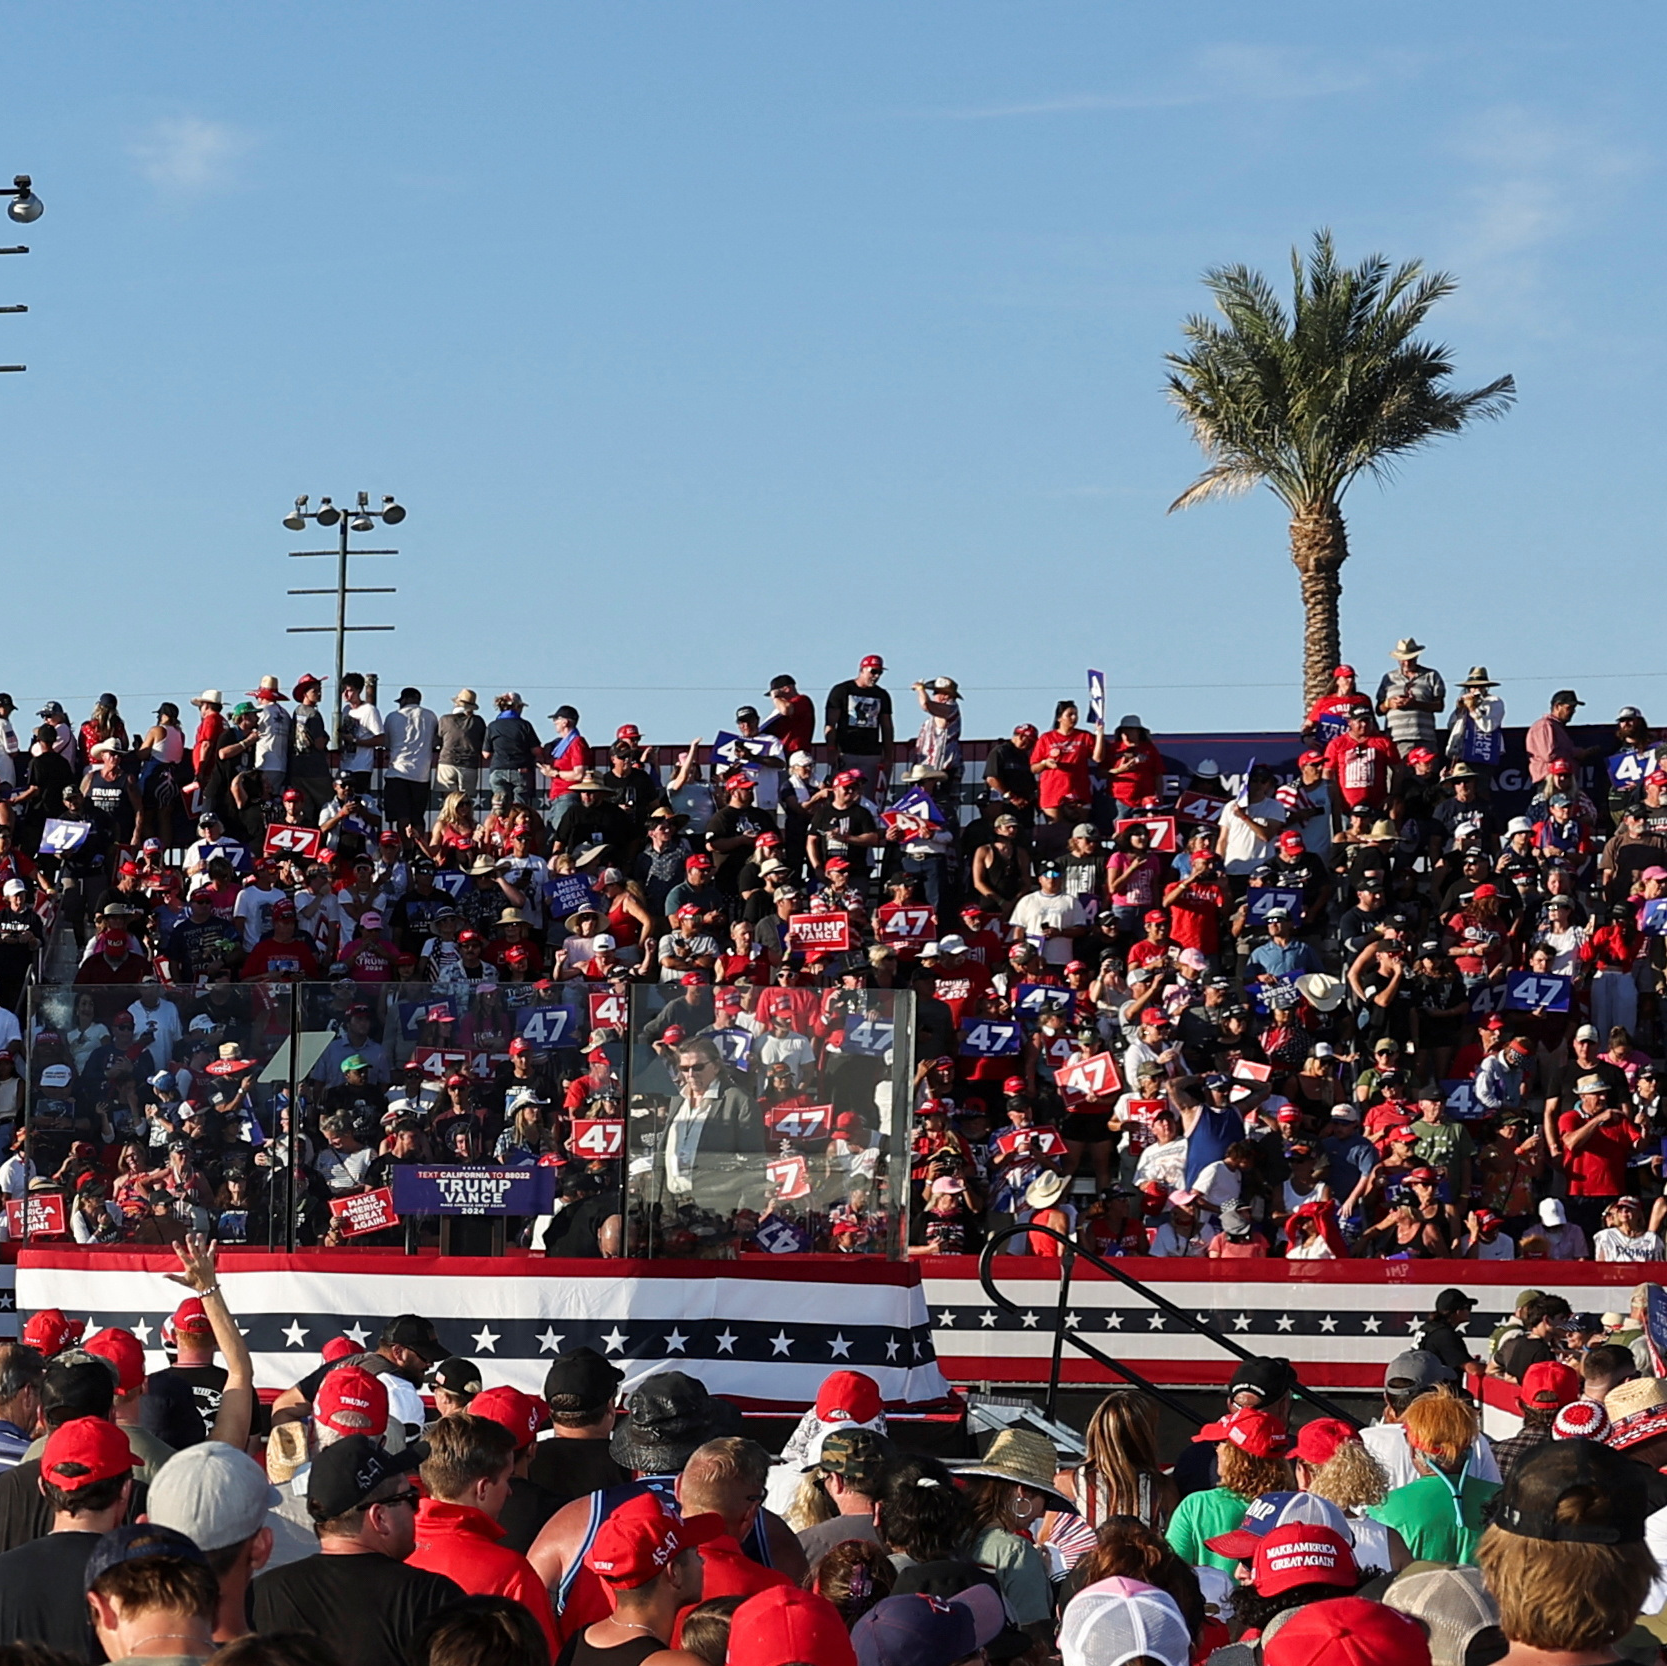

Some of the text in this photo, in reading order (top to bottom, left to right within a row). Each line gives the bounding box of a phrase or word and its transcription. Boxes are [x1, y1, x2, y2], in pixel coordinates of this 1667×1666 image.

[1614, 749, 1657, 781] 47
[92, 788, 122, 797] TRUMP
[46, 824, 86, 850] 47
[269, 829, 315, 852] 47
[1145, 822, 1168, 848] 7
[552, 883, 586, 899] AMERICA
[556, 877, 579, 889] MAKE
[559, 890, 586, 903] GREAT
[1251, 892, 1297, 914] 47
[0, 922, 30, 931] TRUMP
[792, 921, 845, 933] TRUMP
[886, 910, 930, 936] 47
[798, 931, 840, 942] VANCE
[1512, 977, 1563, 1006] 47
[523, 1011, 567, 1042] 47
[966, 1024, 1014, 1051] 47
[1068, 1059, 1108, 1092] 47
[775, 1111, 825, 1137] 47
[578, 1124, 622, 1153] 47
[418, 1171, 531, 1180] TEXT CALIFORNIA TO 88022
[436, 1179, 512, 1193] TRUMP
[347, 1194, 376, 1207] MAKE
[445, 1192, 503, 1204] VANCE
[342, 1201, 387, 1217] AMERICA
[350, 1208, 383, 1223] GREAT
[460, 1207, 485, 1215] 2024
[353, 1217, 387, 1231] AGAIN!
[339, 1396, 370, 1408] TRUMP
[356, 1456, 385, 1490] 45-47
[652, 1531, 681, 1566] 45-47
[1266, 1542, 1338, 1558] MAKE AMERICA
[1270, 1556, 1335, 1572] GREAT AGAIN
